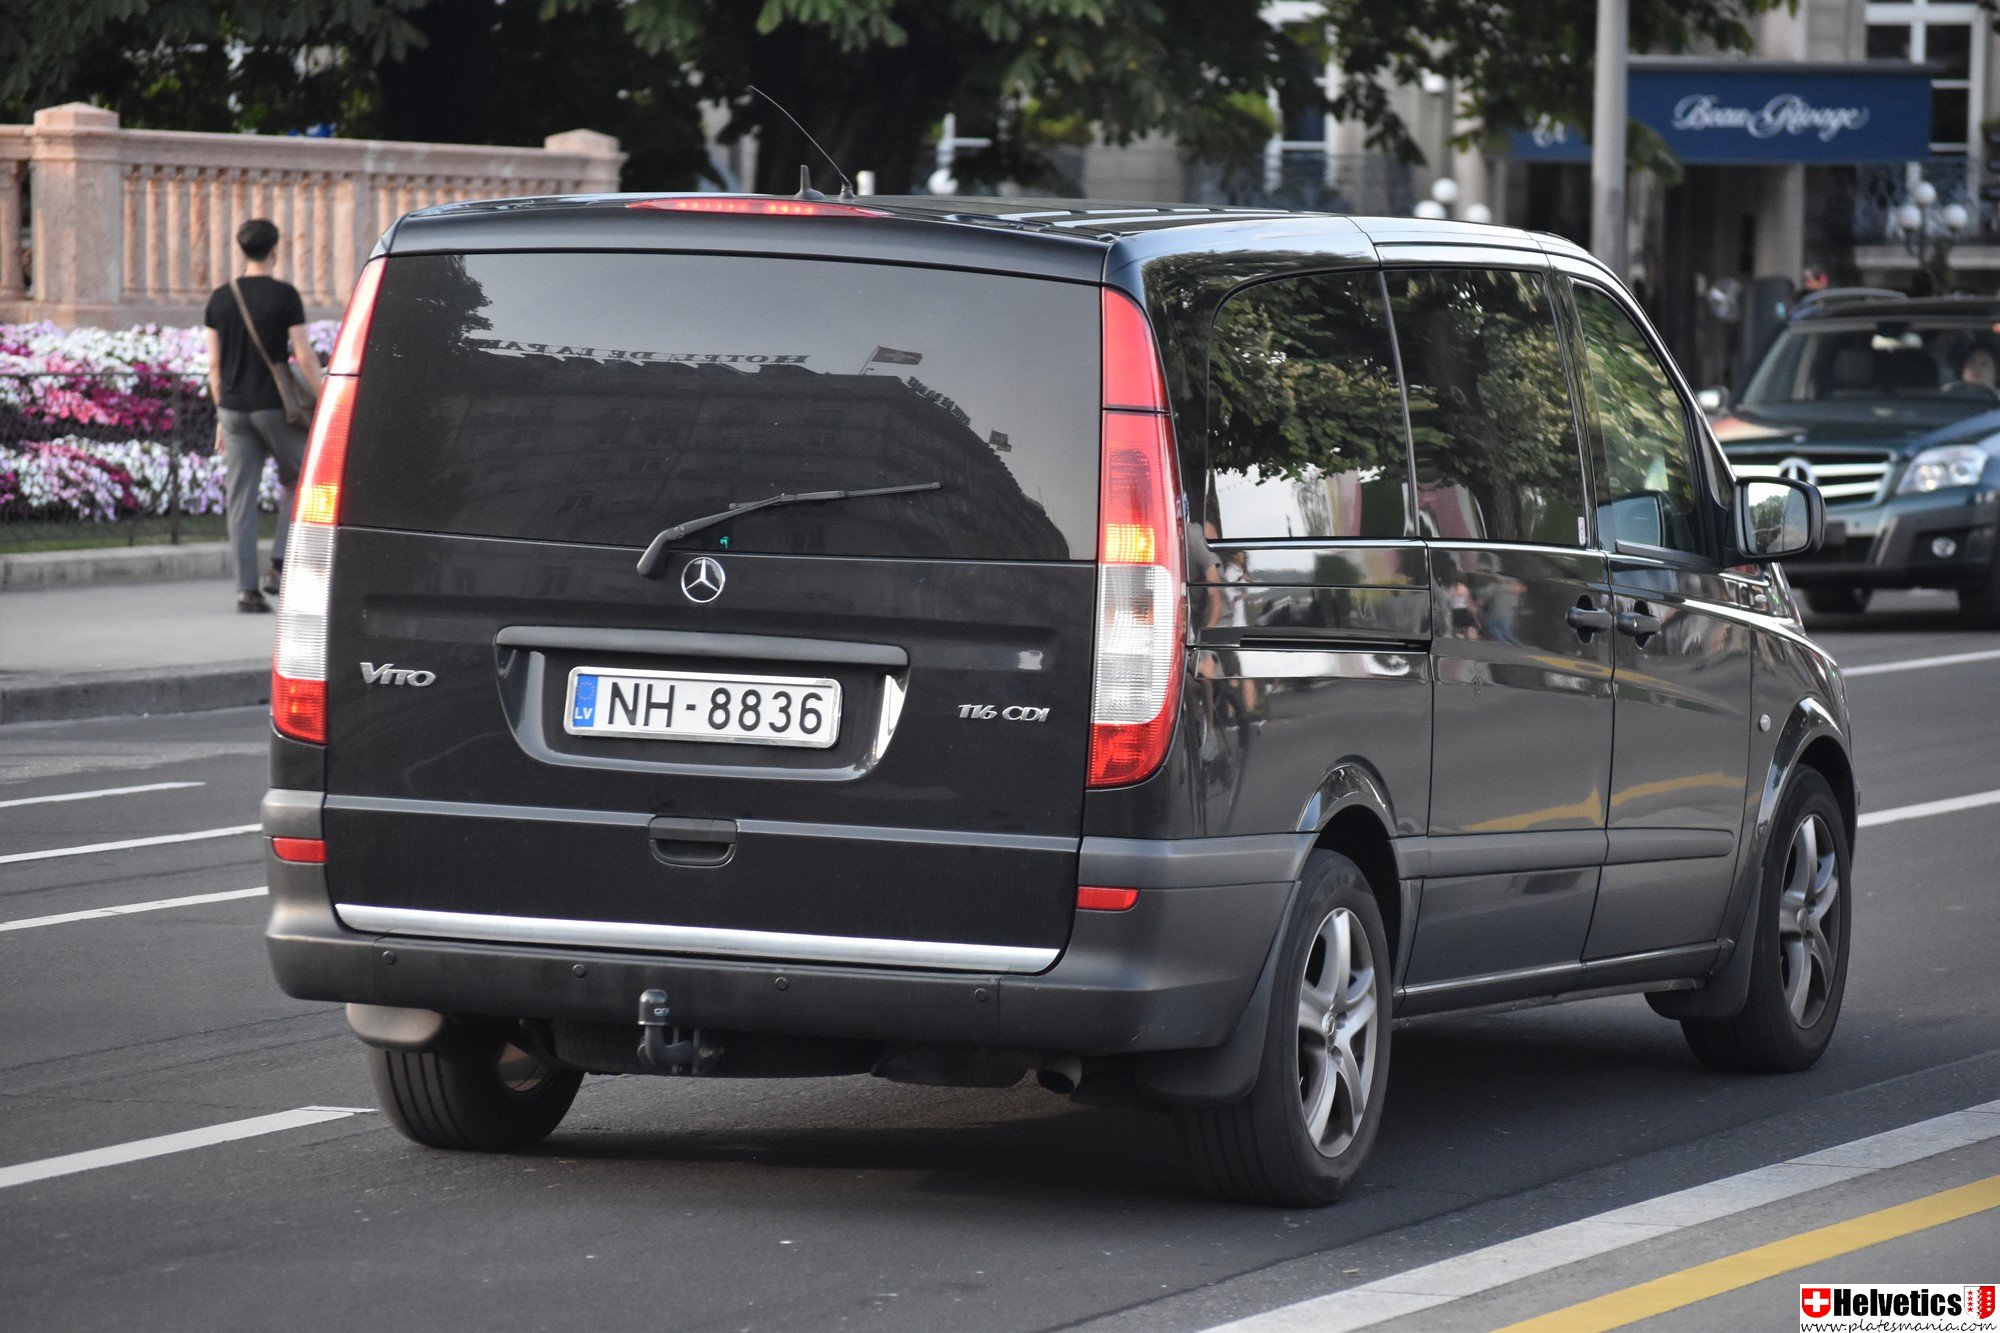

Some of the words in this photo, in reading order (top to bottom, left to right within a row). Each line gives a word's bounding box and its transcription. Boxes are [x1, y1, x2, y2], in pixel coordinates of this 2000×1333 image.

[574, 707, 593, 720] LV
[607, 681, 823, 735] NH-8836
[958, 704, 998, 720] 116
[1001, 705, 1050, 722] CDI
